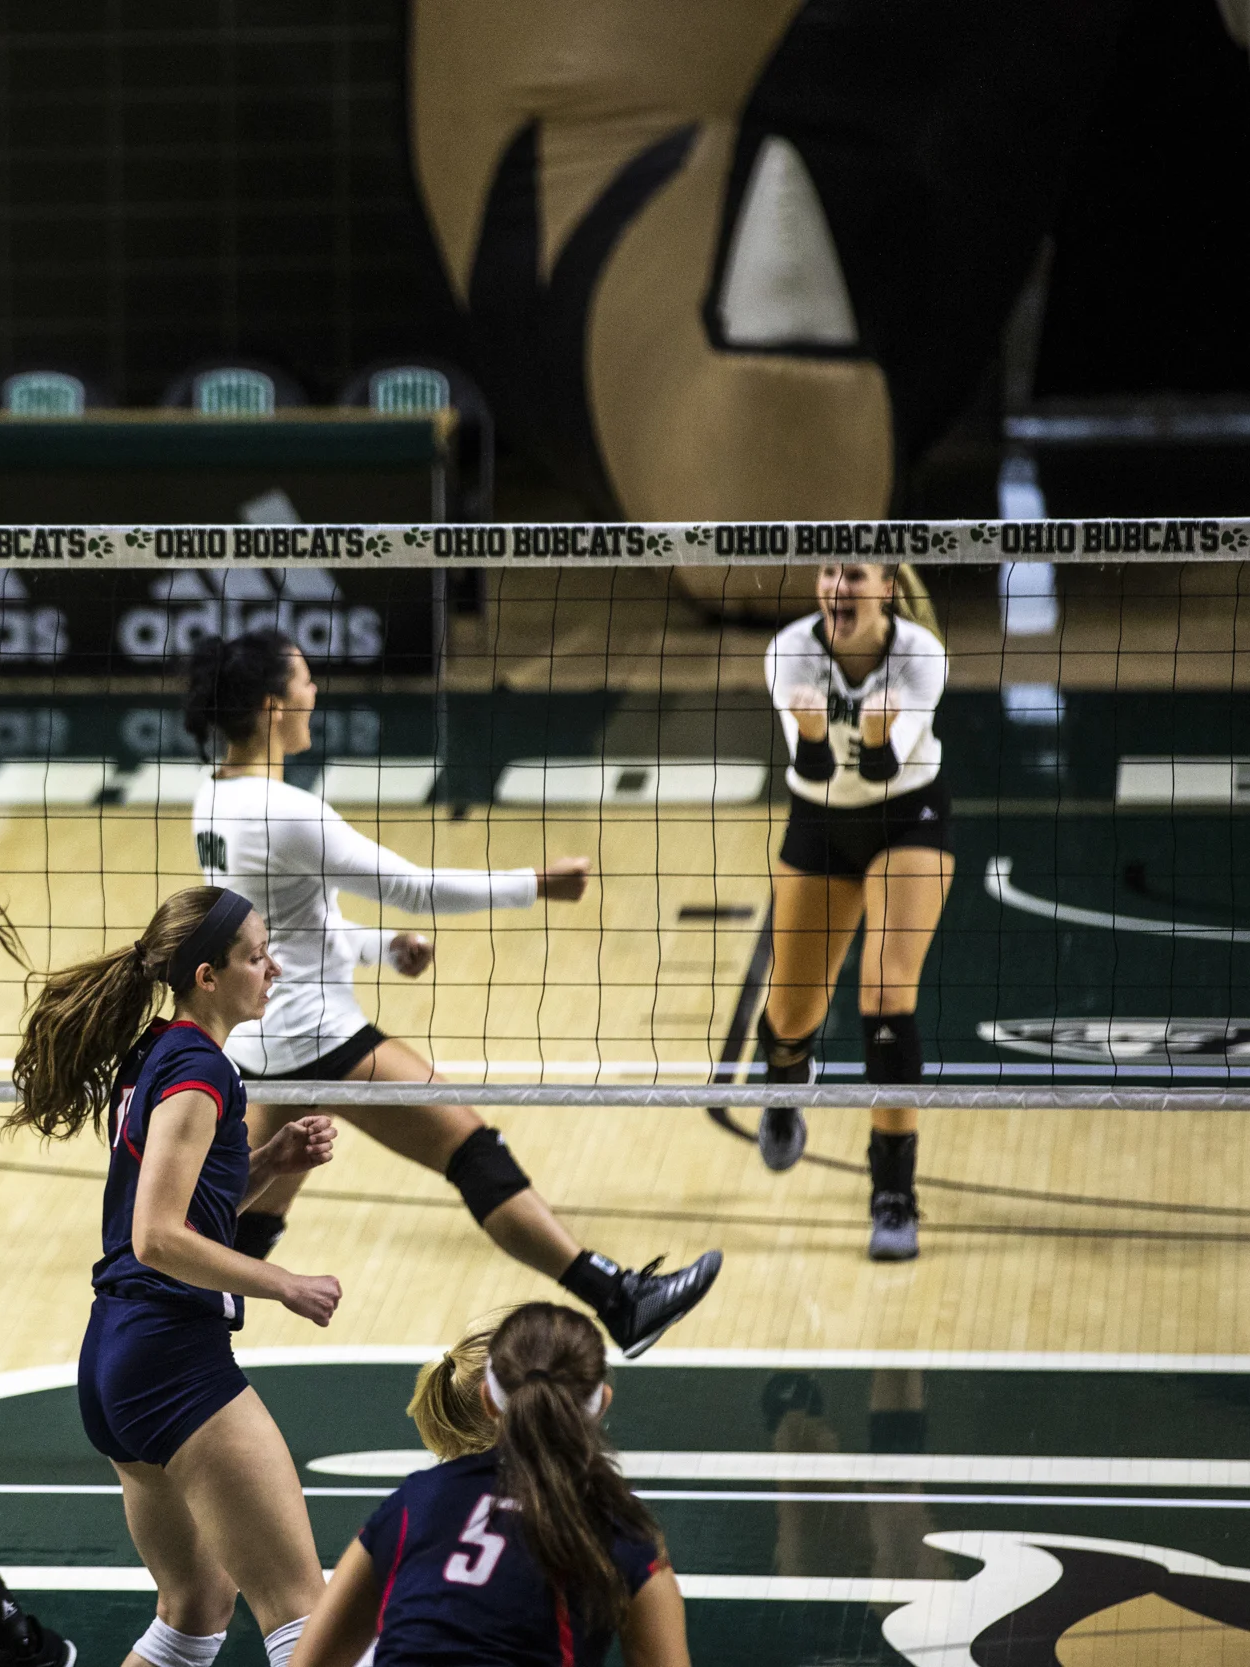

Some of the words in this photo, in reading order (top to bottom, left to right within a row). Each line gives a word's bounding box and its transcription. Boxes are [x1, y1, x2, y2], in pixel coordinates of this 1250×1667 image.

[154, 529, 226, 558] OHIO
[233, 528, 364, 558] BOBCATS
[433, 527, 505, 557] OHIO
[512, 526, 644, 557] BOBCATS
[715, 525, 789, 556] OHIO
[795, 524, 929, 556] BOBCATS
[1002, 523, 1076, 554] OHIO
[1082, 521, 1220, 553] BOBCATS
[442, 1492, 523, 1588] 5
